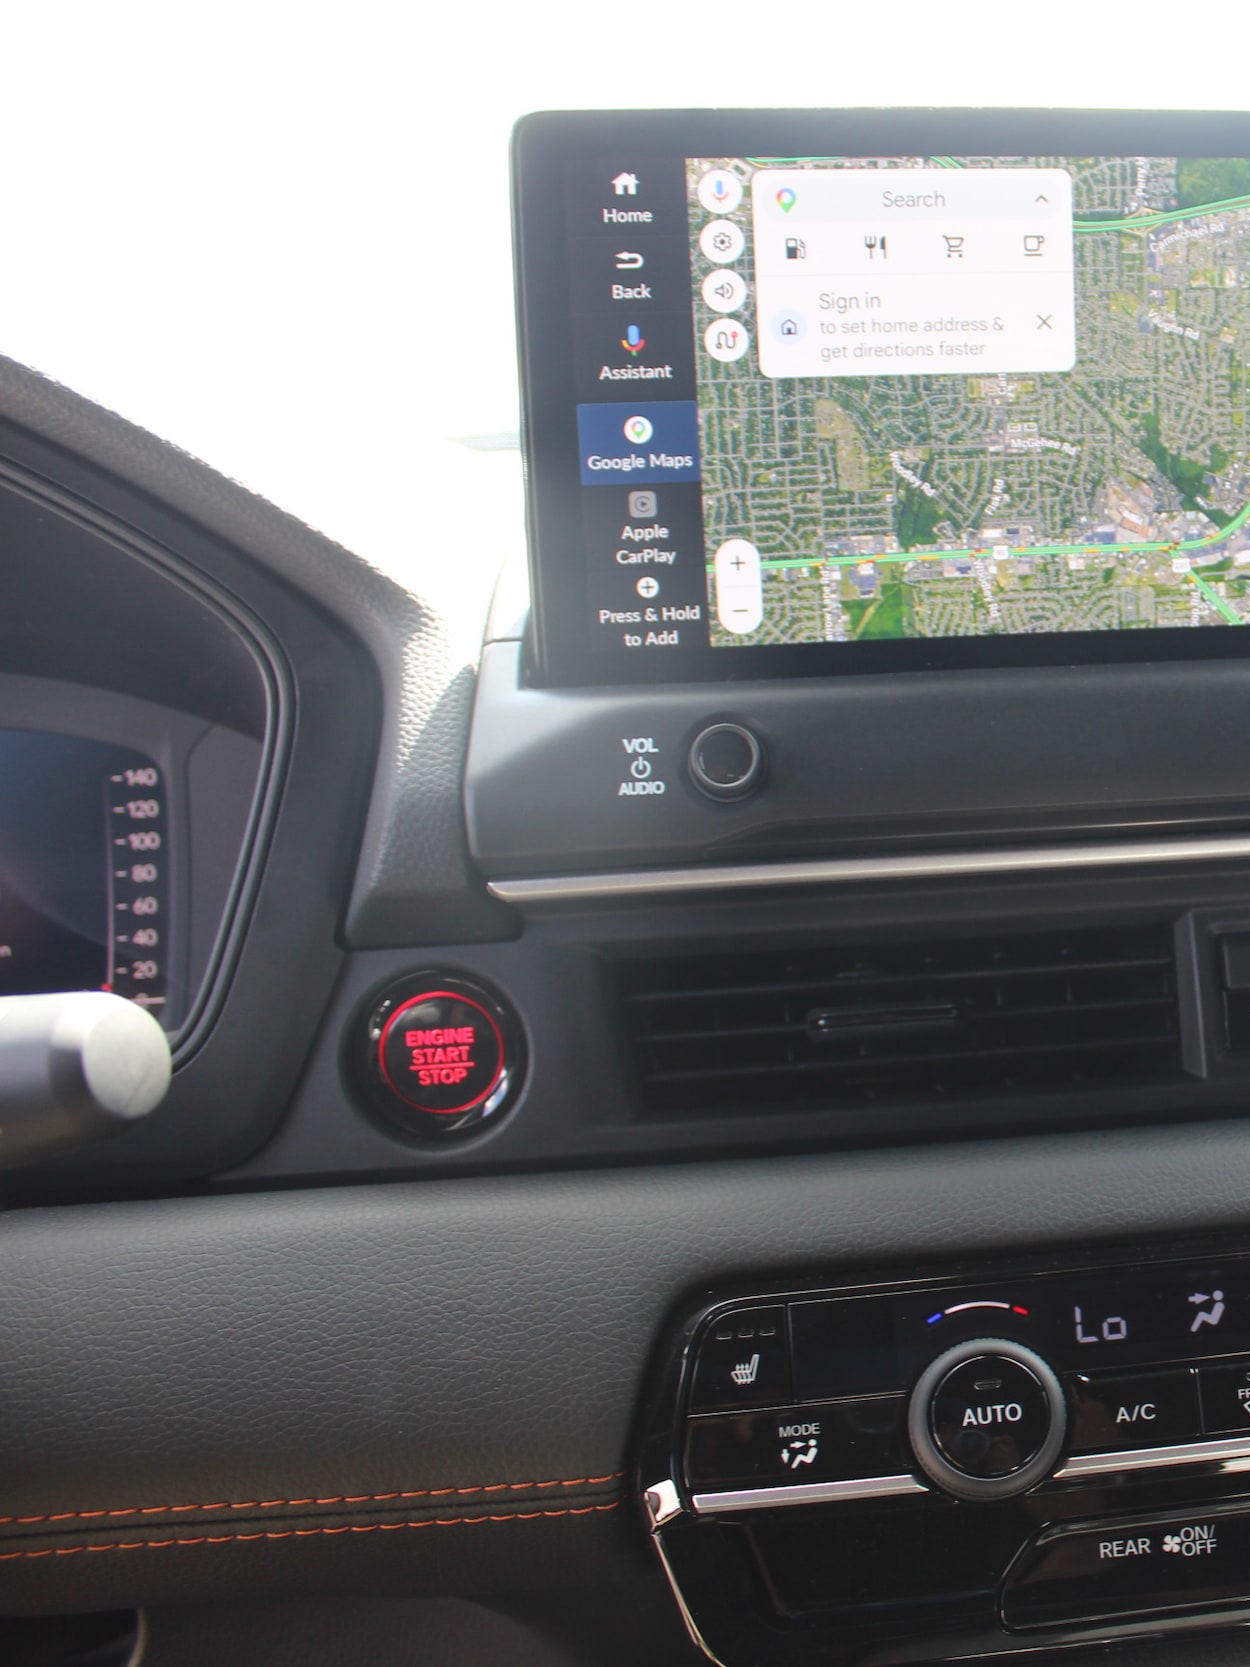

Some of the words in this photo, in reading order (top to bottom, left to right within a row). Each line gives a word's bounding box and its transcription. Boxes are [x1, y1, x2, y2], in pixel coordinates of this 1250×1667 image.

[882, 190, 946, 208] Search
[602, 208, 653, 223] Home
[1150, 225, 1209, 253] Carmichael
[1210, 223, 1225, 233] Rd
[611, 283, 652, 299] Back
[819, 292, 860, 314] Sign
[865, 291, 881, 309] in
[820, 320, 837, 334] to
[841, 320, 867, 334] set
[872, 318, 919, 333] home
[923, 317, 988, 333] address
[992, 316, 1005, 331] &
[820, 345, 848, 362] get
[853, 342, 934, 358] directions
[939, 341, 985, 356] faster
[598, 364, 673, 380] Assistant
[587, 453, 646, 472] Google
[649, 453, 694, 470] Maps
[920, 482, 936, 496] Rd
[621, 524, 670, 541] Apple
[615, 548, 677, 565] CarPlay
[599, 609, 641, 624] Press
[644, 607, 659, 622] &
[662, 605, 701, 620] Hold
[624, 633, 642, 646] to
[645, 630, 679, 645] Add
[622, 738, 659, 754] VOL
[124, 768, 158, 786] 140
[618, 781, 666, 796] AUDIO
[127, 799, 160, 818] 120
[128, 831, 161, 850] 100
[131, 863, 157, 882] 80
[132, 896, 158, 916] 60
[132, 928, 158, 947] 40
[132, 960, 158, 979] 20
[405, 1027, 475, 1047] ENGINE
[411, 1045, 471, 1065] START
[418, 1068, 468, 1086] STOP
[1074, 1305, 1127, 1343] Lo
[962, 1402, 1023, 1427] AUTO
[1115, 1403, 1157, 1423] A/C
[778, 1422, 821, 1438] MODE
[1099, 1537, 1152, 1559] REAR
[1180, 1524, 1216, 1542] ON/
[1181, 1539, 1218, 1557] OFF
